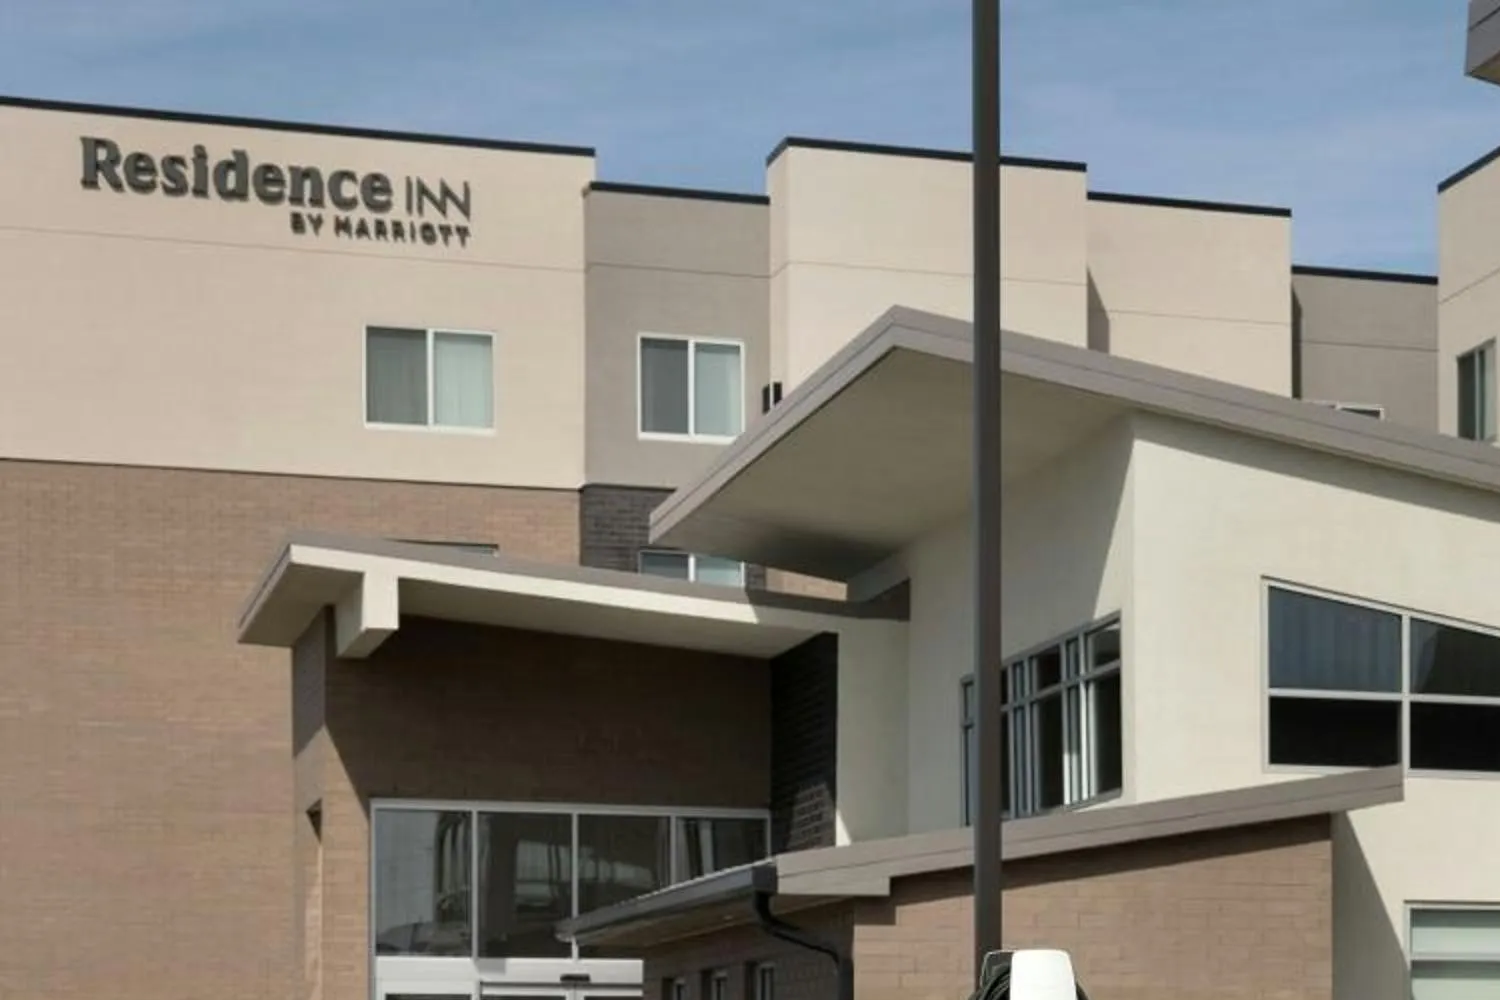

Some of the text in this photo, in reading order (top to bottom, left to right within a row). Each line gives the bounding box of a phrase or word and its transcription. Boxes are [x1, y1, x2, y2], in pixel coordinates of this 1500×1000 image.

[79, 135, 471, 221] Residence INN
[289, 211, 472, 247] BY MARRIOTT
